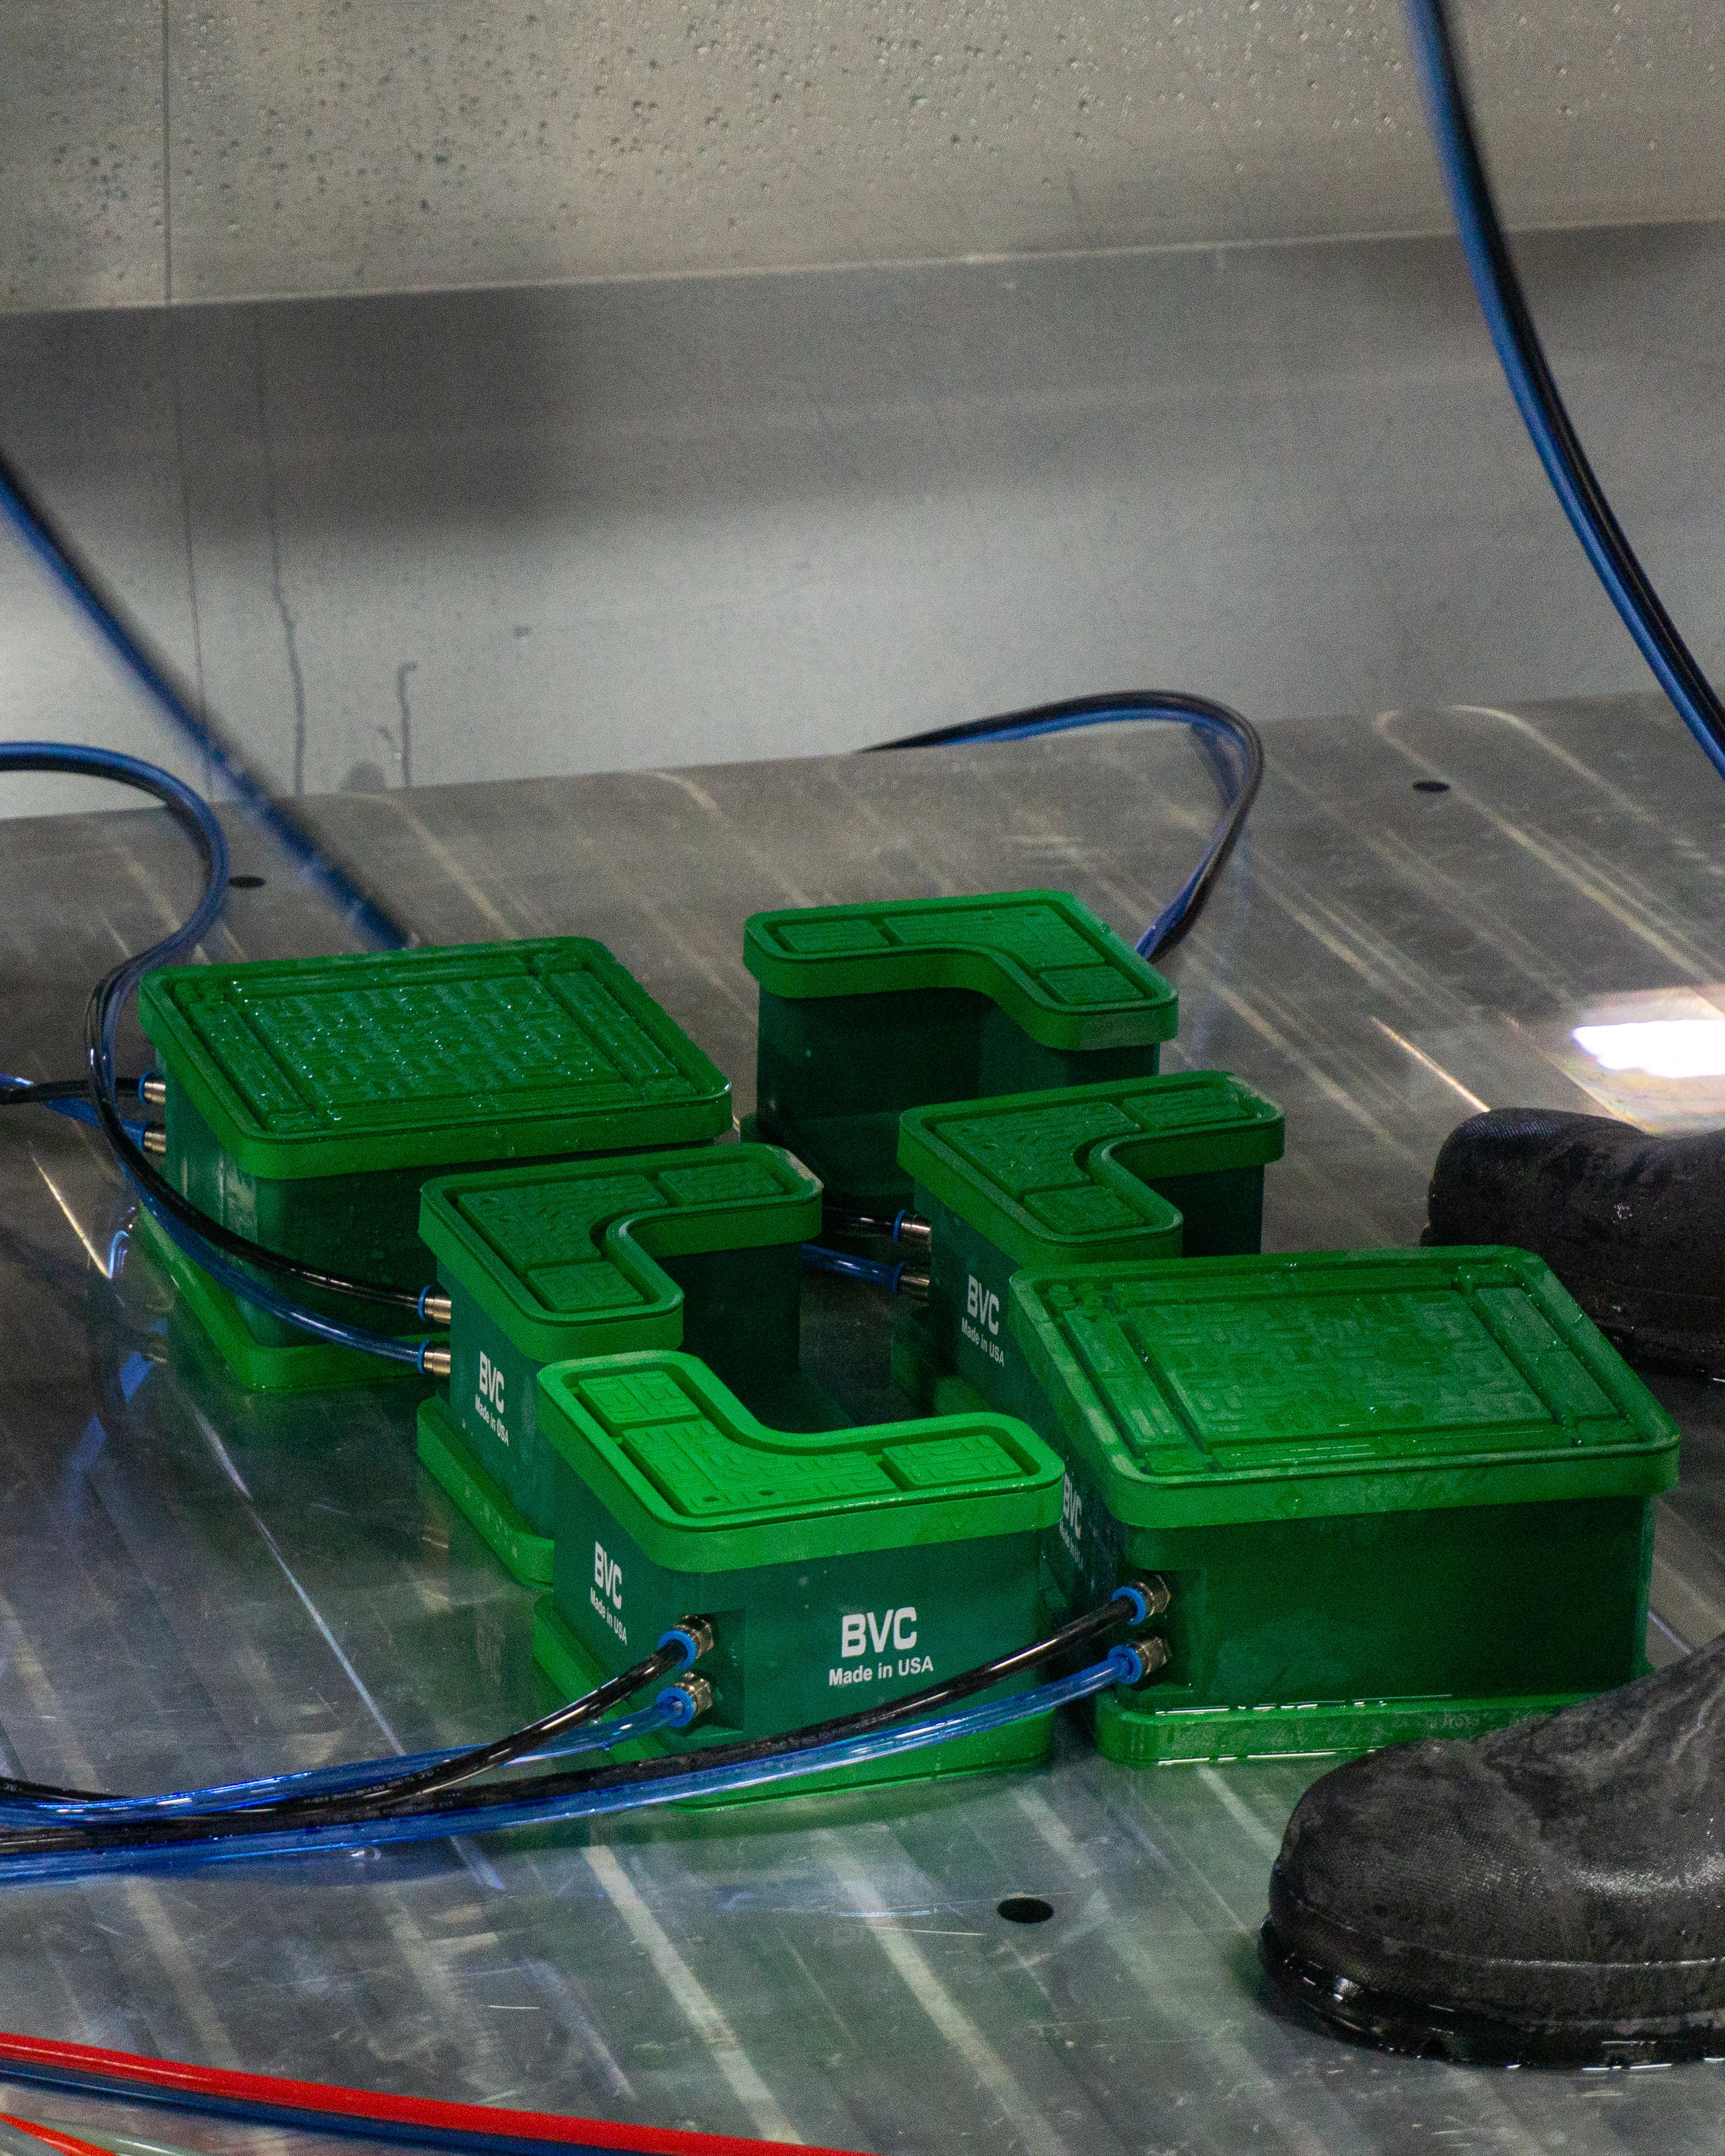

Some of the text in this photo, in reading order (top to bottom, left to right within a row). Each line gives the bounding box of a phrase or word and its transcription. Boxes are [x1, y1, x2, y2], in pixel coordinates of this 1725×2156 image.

[968, 1275, 999, 1335] BVC
[962, 1317, 1004, 1367] Made in USA
[479, 1351, 504, 1413] BVC
[475, 1394, 509, 1447] Made in USA
[1063, 1472, 1082, 1540] BVC
[595, 1542, 622, 1609] BVC
[590, 1587, 627, 1645] Made in USA
[841, 1607, 917, 1657] BVC
[829, 1656, 934, 1686] Made in USA
